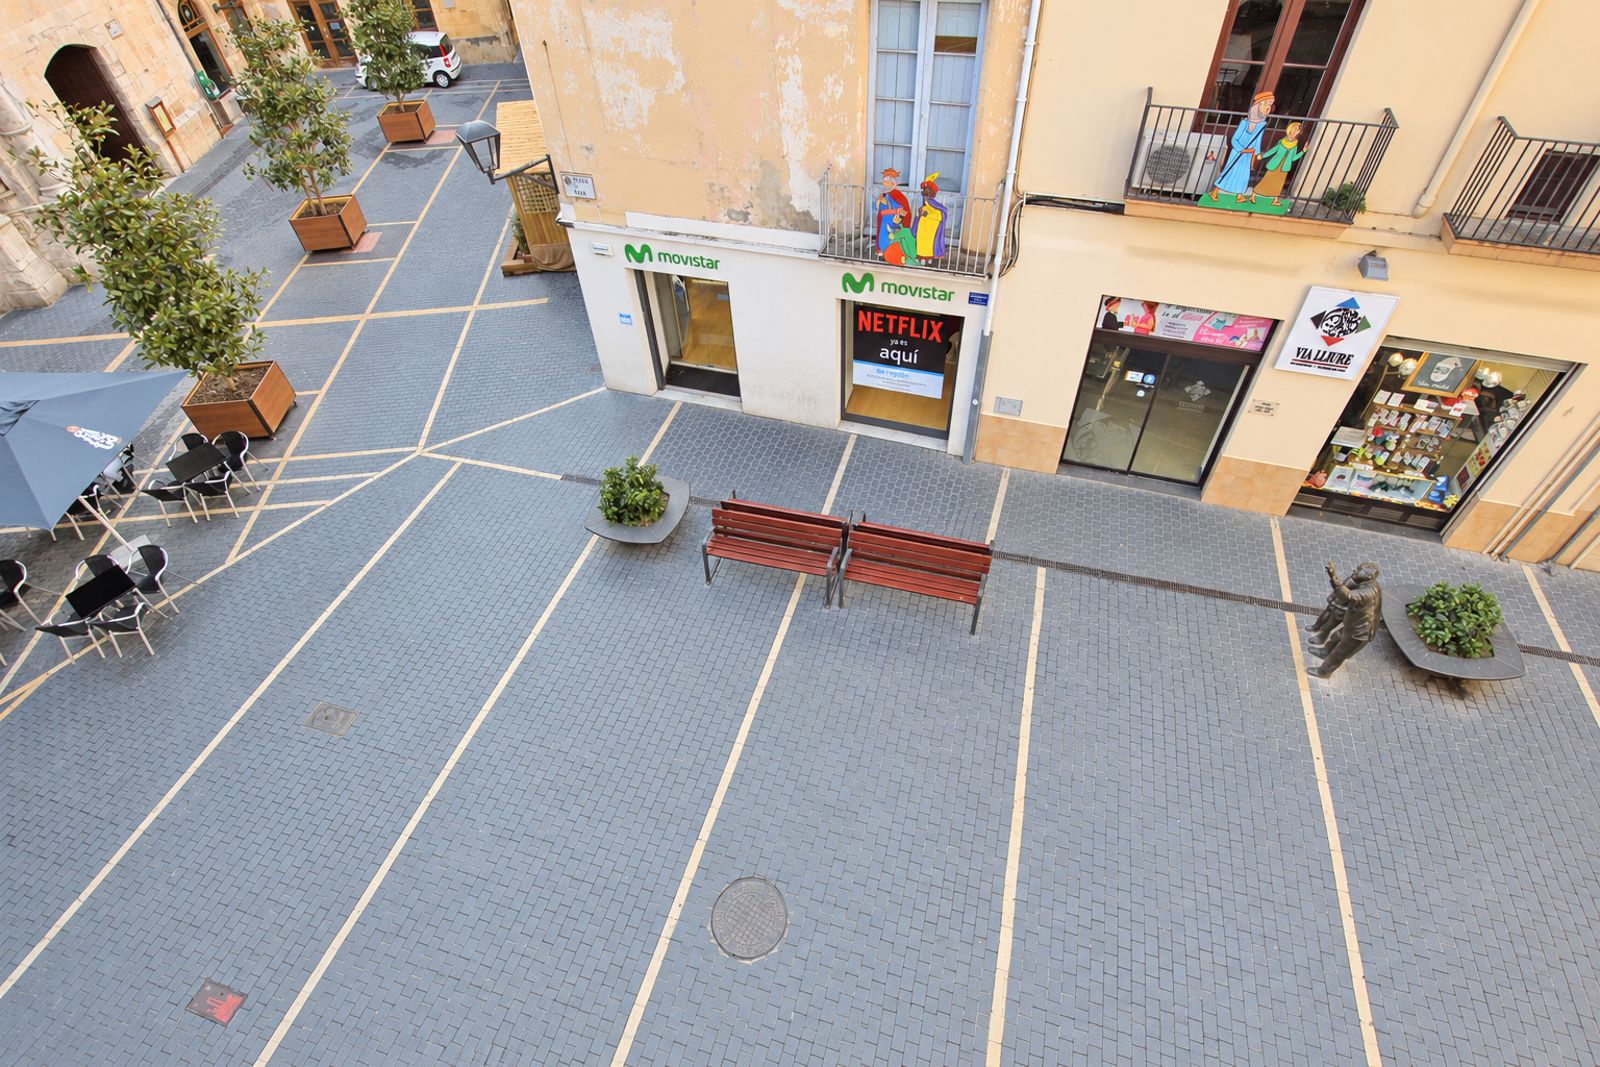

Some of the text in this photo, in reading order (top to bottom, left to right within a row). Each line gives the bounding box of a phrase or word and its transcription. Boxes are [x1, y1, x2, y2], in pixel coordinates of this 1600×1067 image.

[656, 251, 720, 269] movistar
[880, 282, 954, 302] movistar
[858, 310, 944, 343] NETFLIX
[879, 347, 919, 365] aquí
[1296, 347, 1354, 365] VIA LLIURE
